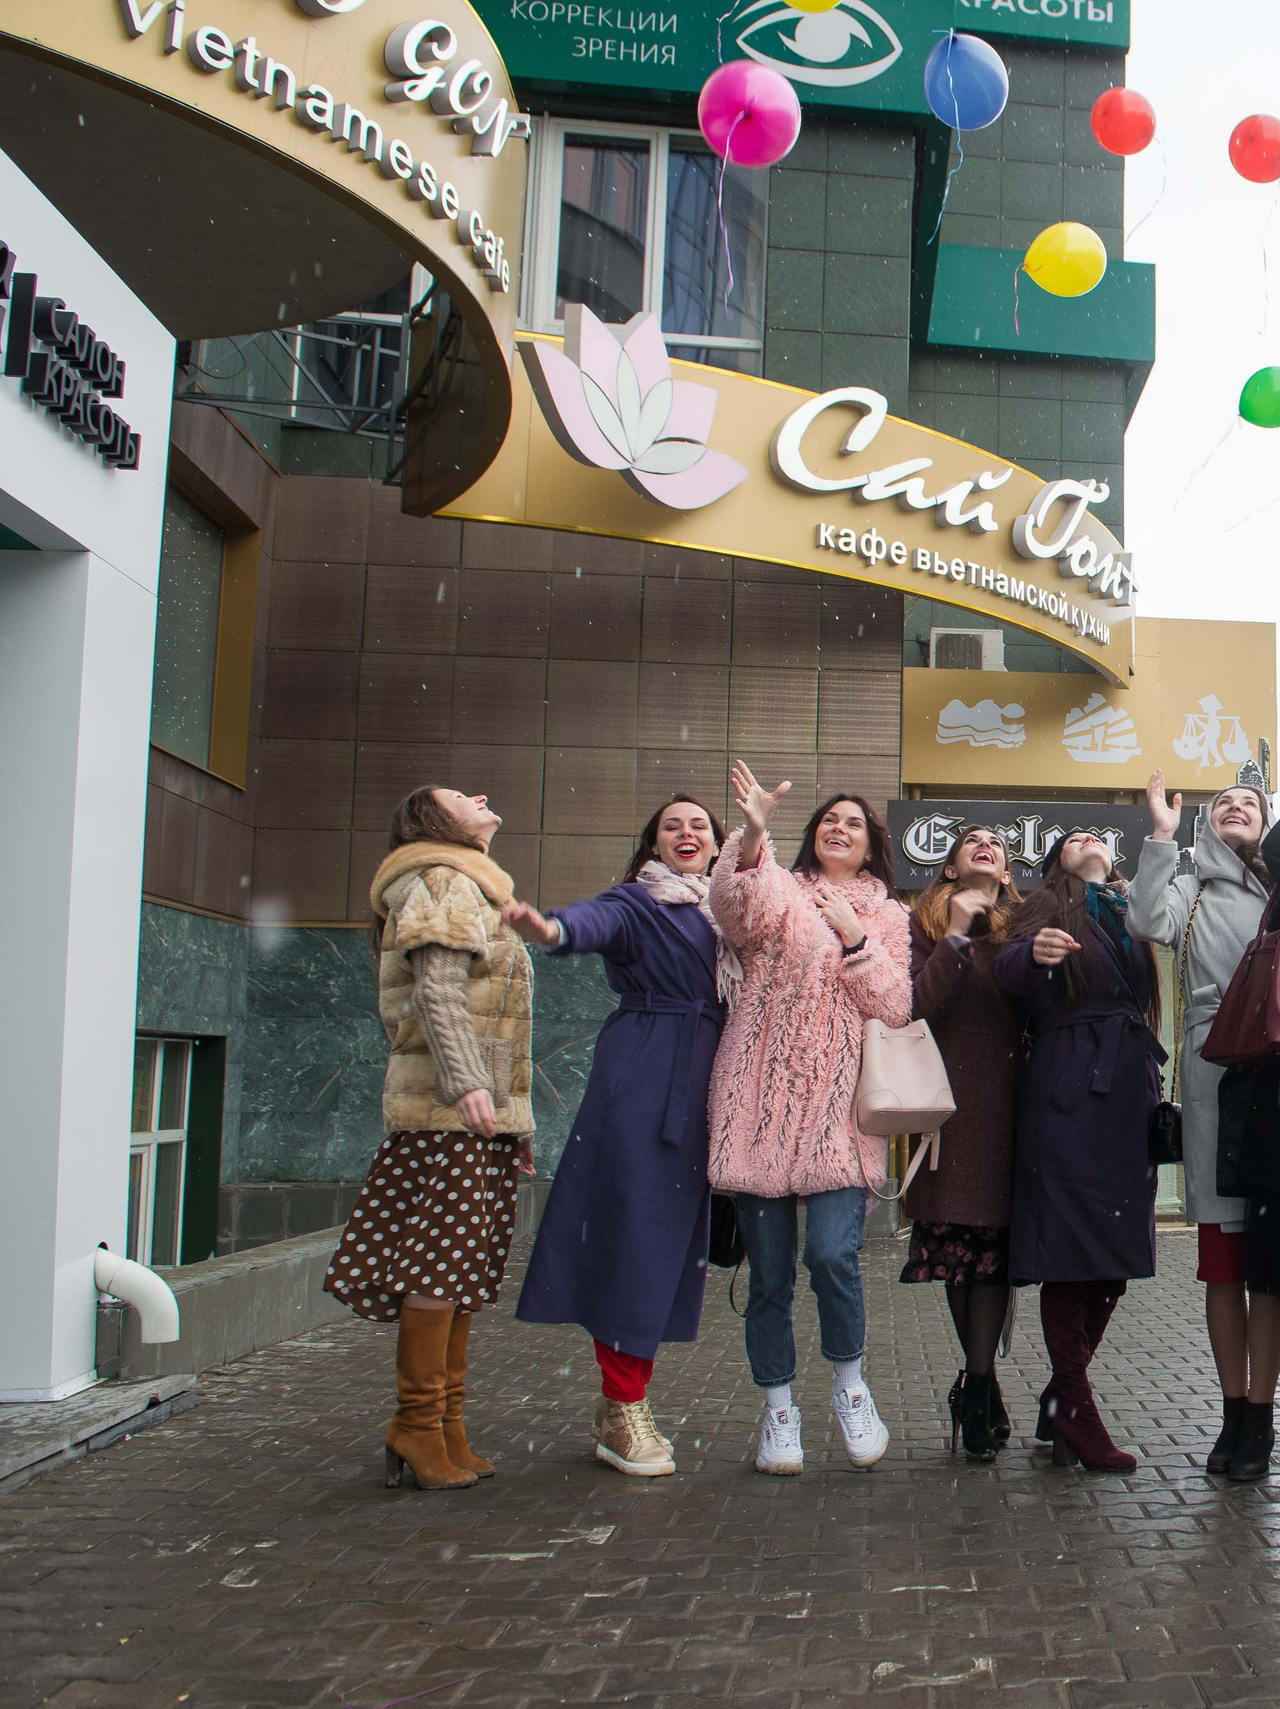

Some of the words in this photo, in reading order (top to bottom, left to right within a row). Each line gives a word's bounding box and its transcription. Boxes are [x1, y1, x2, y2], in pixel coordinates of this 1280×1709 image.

[511, 0, 678, 35] КОРРЕКЦИИ
[571, 36, 676, 66] ЗРЕНИЯ
[119, 0, 461, 220] vietnamese
[457, 210, 511, 294] cafe
[34, 297, 126, 399] САЛОН
[23, 352, 142, 470] КРАСОТЫ
[769, 386, 1014, 534] Сай
[817, 522, 907, 566] кафе
[913, 547, 1068, 623] вьетнамской
[1068, 605, 1110, 647] кухни
